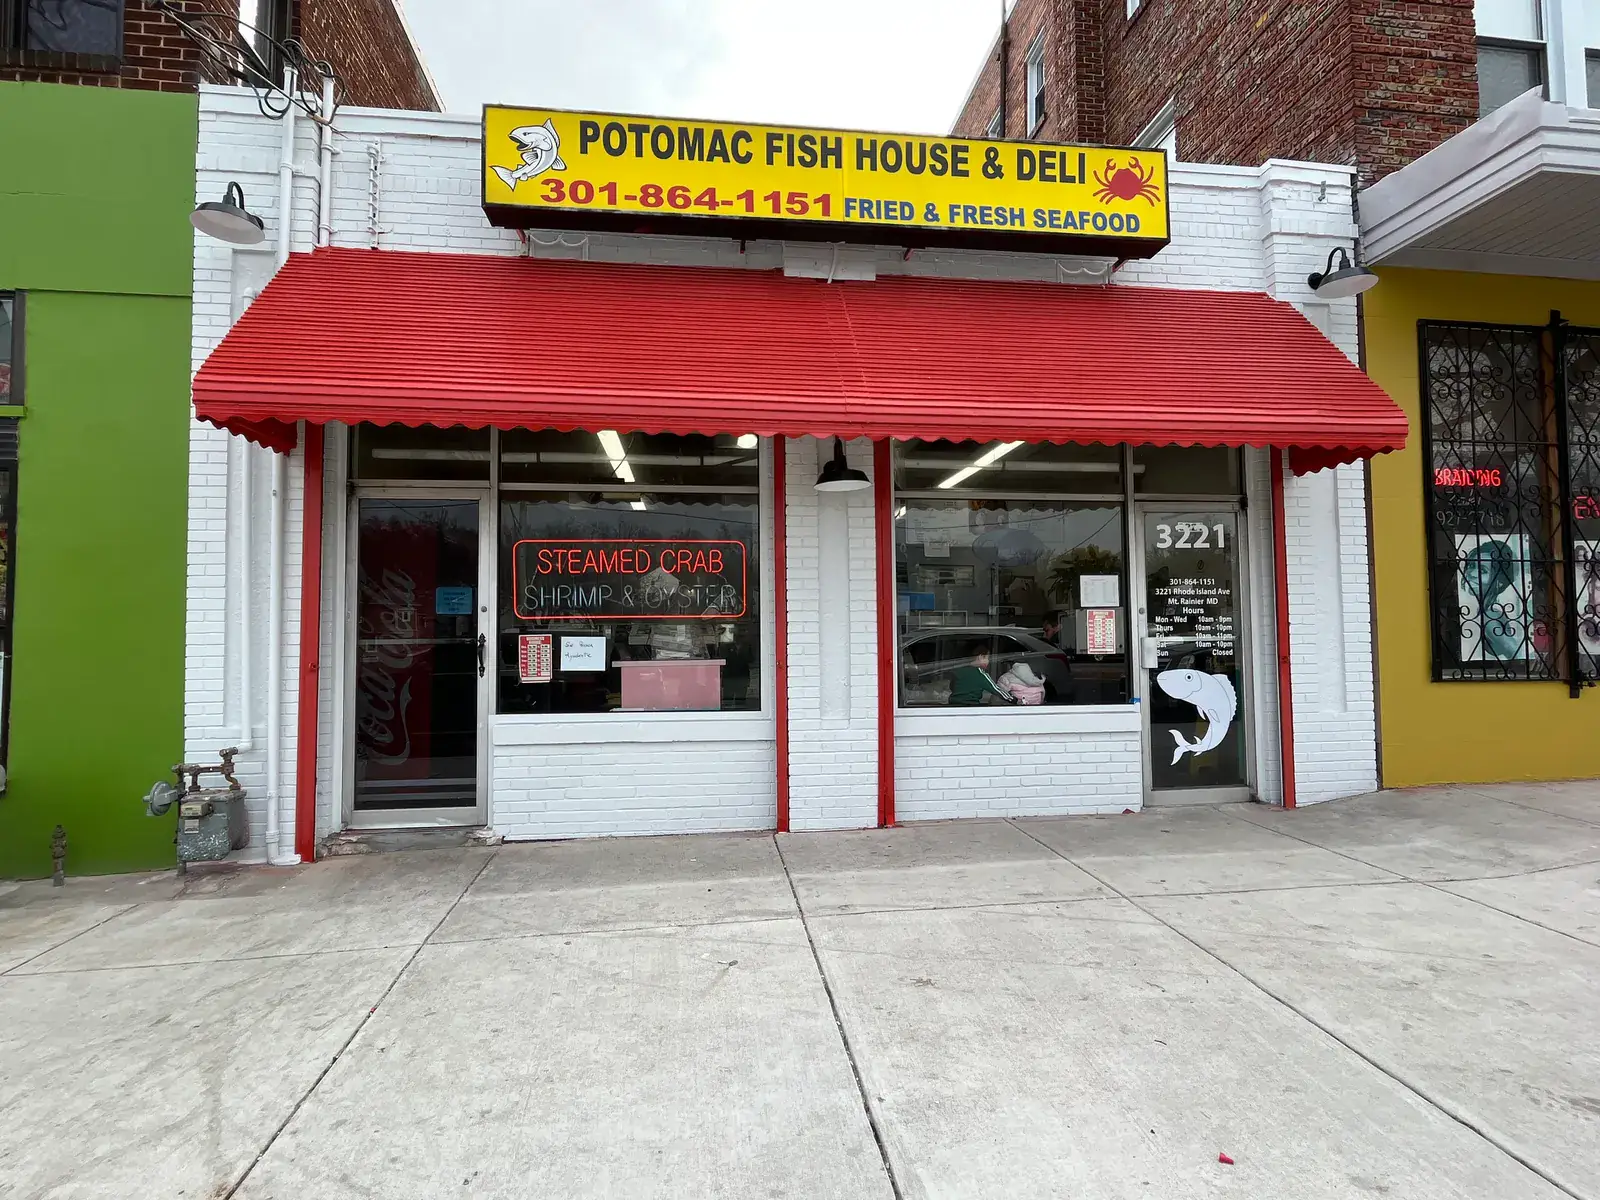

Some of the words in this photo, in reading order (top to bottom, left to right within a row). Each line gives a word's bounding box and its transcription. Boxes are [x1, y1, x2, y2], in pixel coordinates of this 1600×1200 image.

[579, 120, 753, 164] POTOMAC
[765, 132, 843, 169] FISH
[856, 138, 970, 178] HOUSE
[981, 146, 1005, 179] &
[1016, 149, 1086, 184] DELI
[540, 178, 831, 217] 301-864-1151
[844, 197, 915, 221] FRIED
[923, 203, 940, 222] &
[949, 204, 1025, 226] FRESH
[1033, 208, 1140, 233] SEAFOOD
[1156, 523, 1225, 549] 3221
[537, 549, 651, 575] STEAMED
[659, 549, 724, 575] CRAB
[523, 584, 613, 610] SHRIMP
[622, 585, 635, 608] &
[645, 584, 737, 608] OYSTER
[1155, 588, 1172, 596] 3221
[1216, 624, 1233, 632] 10pm
[1216, 641, 1233, 649] 10pm
